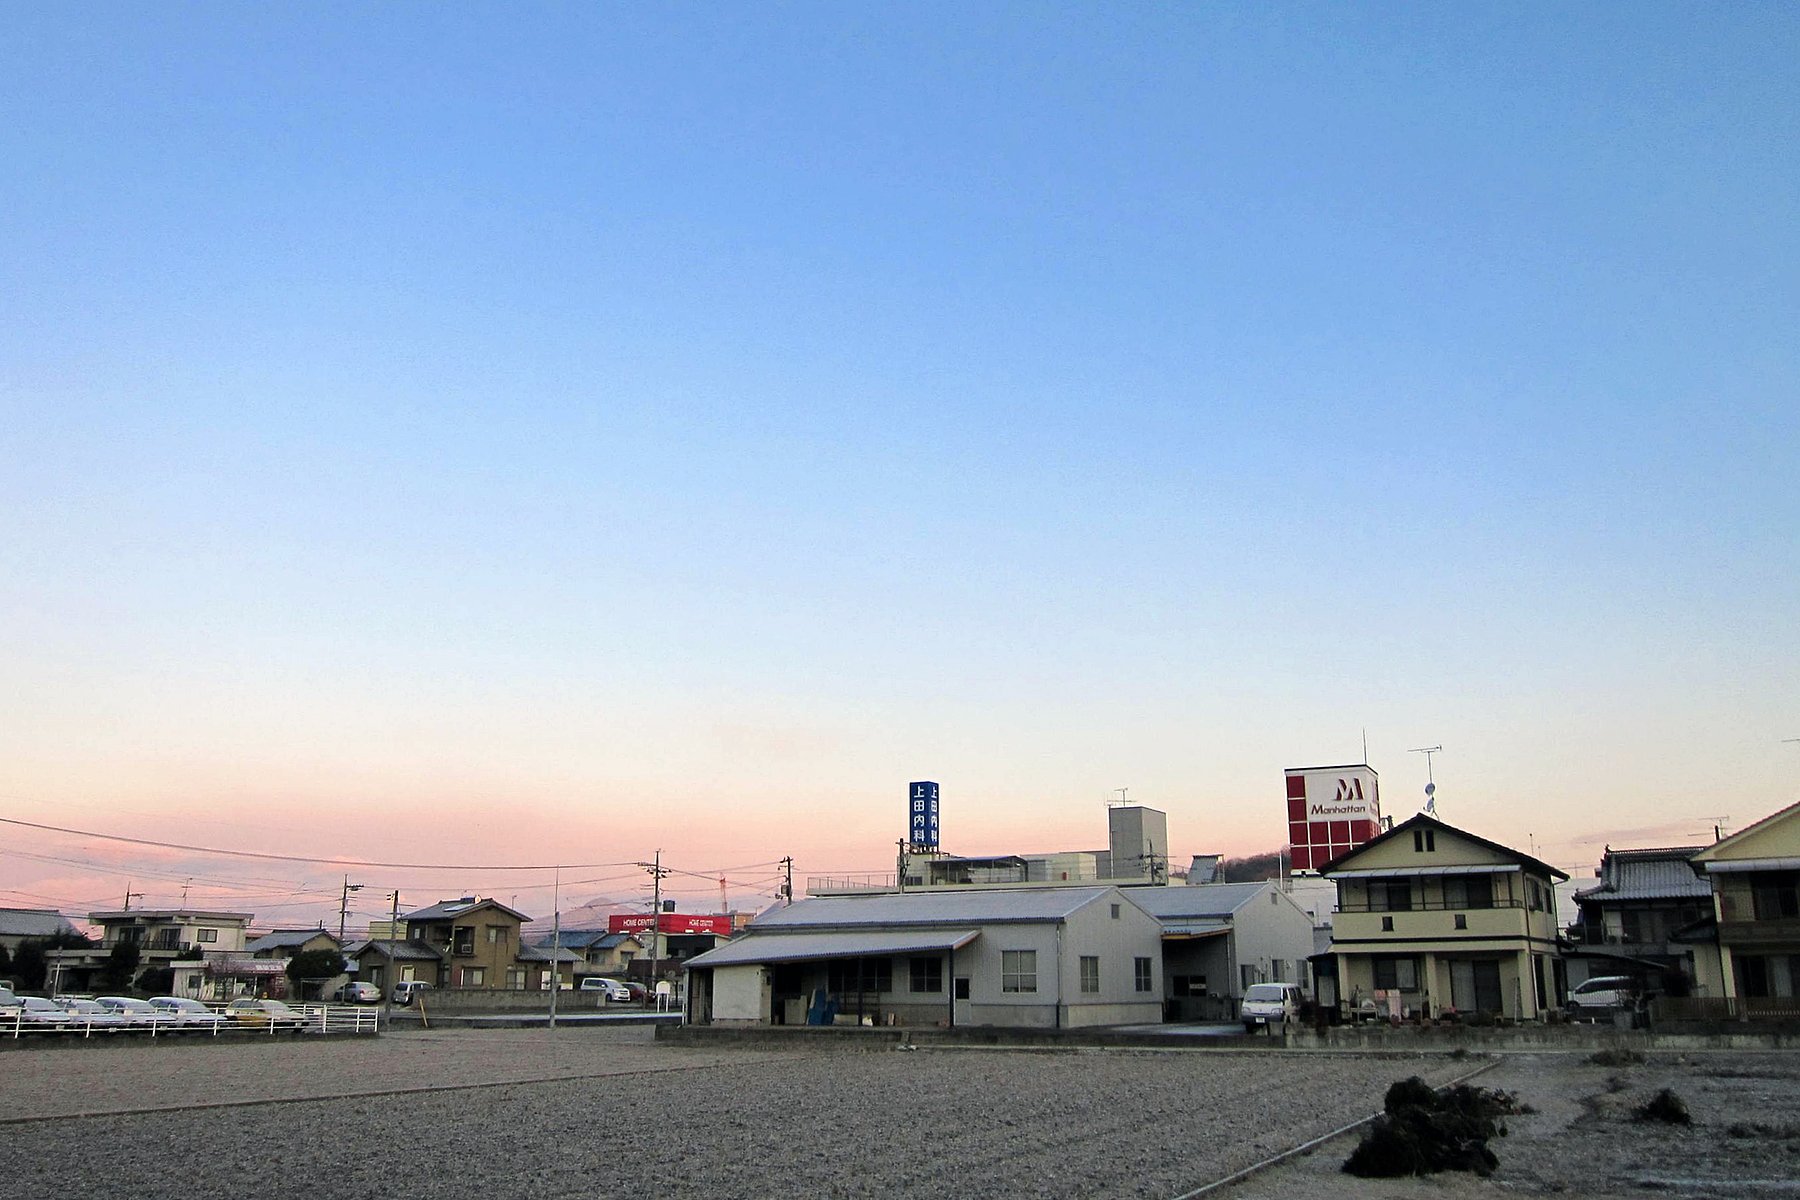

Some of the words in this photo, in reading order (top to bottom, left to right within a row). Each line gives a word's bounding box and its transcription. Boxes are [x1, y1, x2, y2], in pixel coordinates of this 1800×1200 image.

[913, 785, 925, 842] 上田内科
[1311, 804, 1366, 815] Manhattan
[623, 919, 637, 927] HOME
